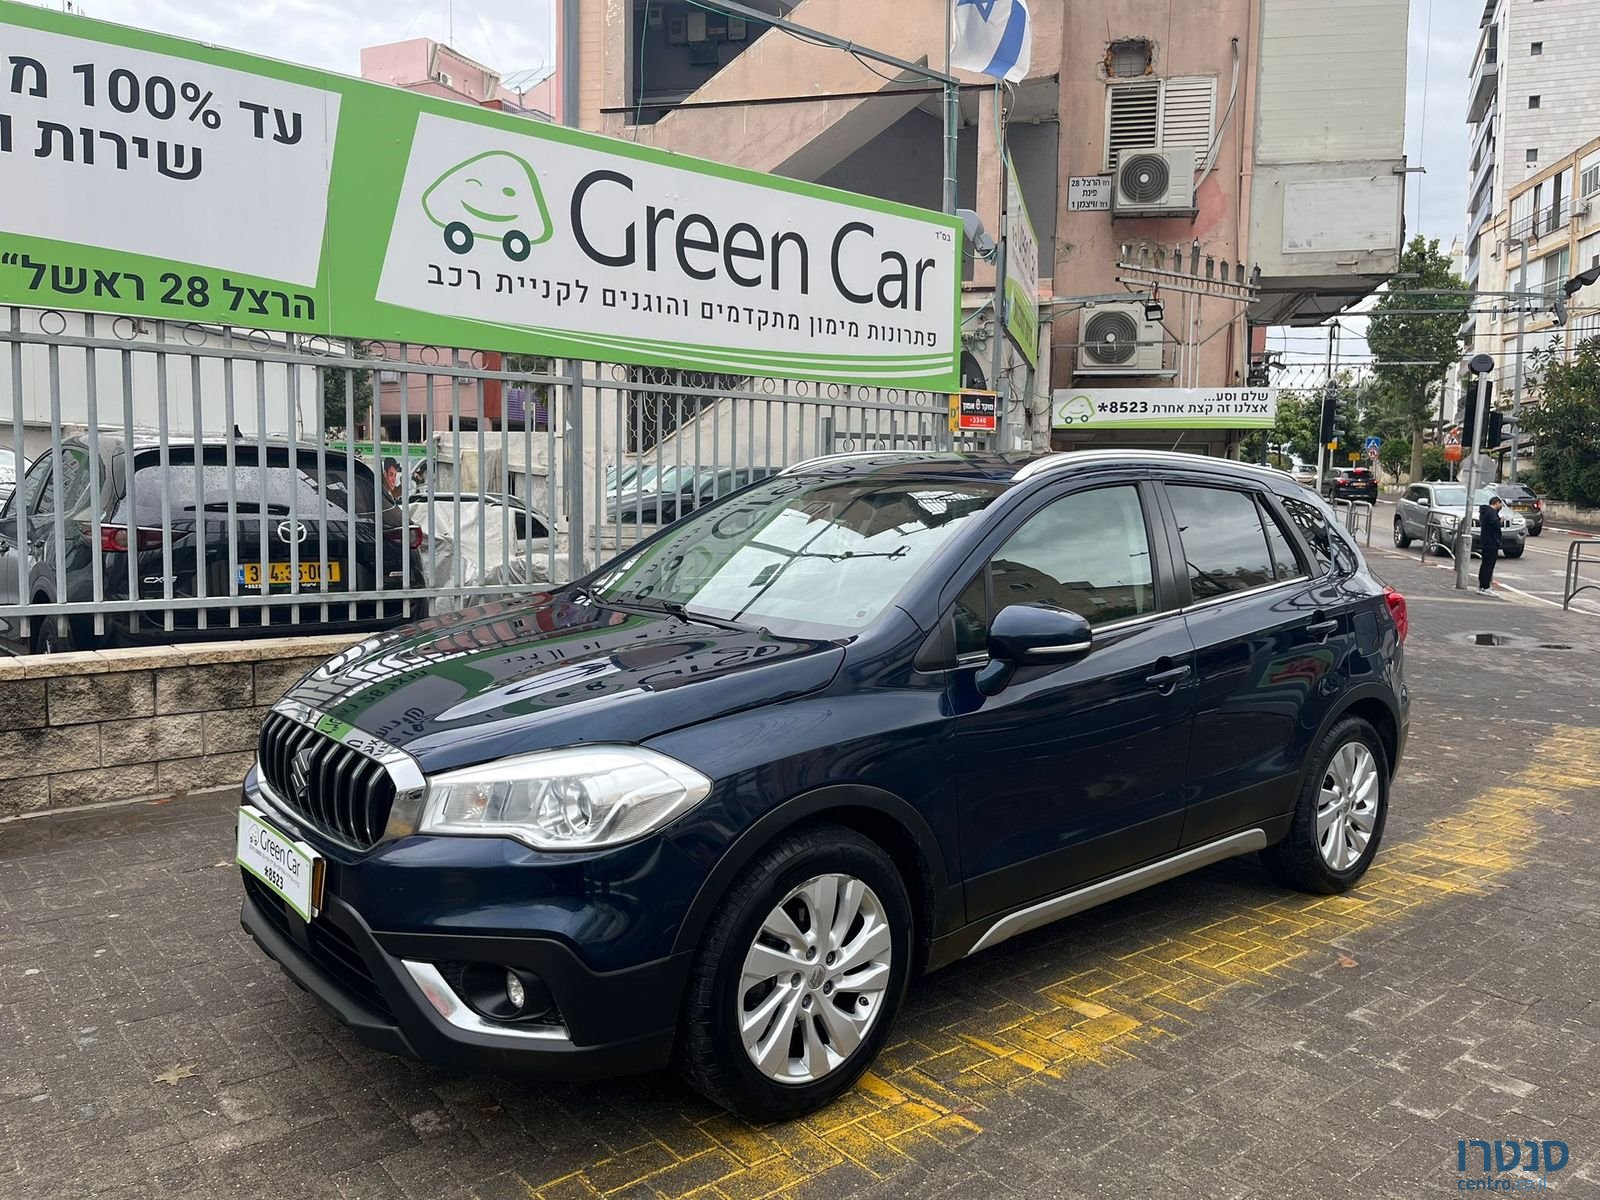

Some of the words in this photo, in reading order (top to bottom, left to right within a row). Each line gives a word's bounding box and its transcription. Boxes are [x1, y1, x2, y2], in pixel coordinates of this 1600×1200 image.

[73, 63, 221, 130] 100%
[240, 101, 302, 145] עד
[35, 120, 202, 181] שירות
[1071, 179, 1080, 187] 28
[1081, 177, 1101, 187] הרצל
[1082, 189, 1098, 197] פינת
[1071, 200, 1075, 209] 1
[570, 169, 810, 296] Green
[830, 222, 936, 313] Car
[427, 263, 481, 290] רכב
[160, 272, 210, 308] 28
[222, 278, 315, 321] הרצל
[495, 273, 589, 307] לקניית
[602, 288, 689, 317] והוגנים
[701, 301, 800, 332] מתקדמים
[809, 316, 859, 338] מימון
[867, 324, 937, 347] פתרונות
[1152, 404, 1185, 413] אחרת
[1217, 404, 1231, 413] זה
[1234, 403, 1268, 413] אצלנו
[1241, 391, 1269, 402] שלם
[1187, 404, 1213, 416] קצת
[260, 829, 286, 866] Green
[286, 849, 301, 878] Car
